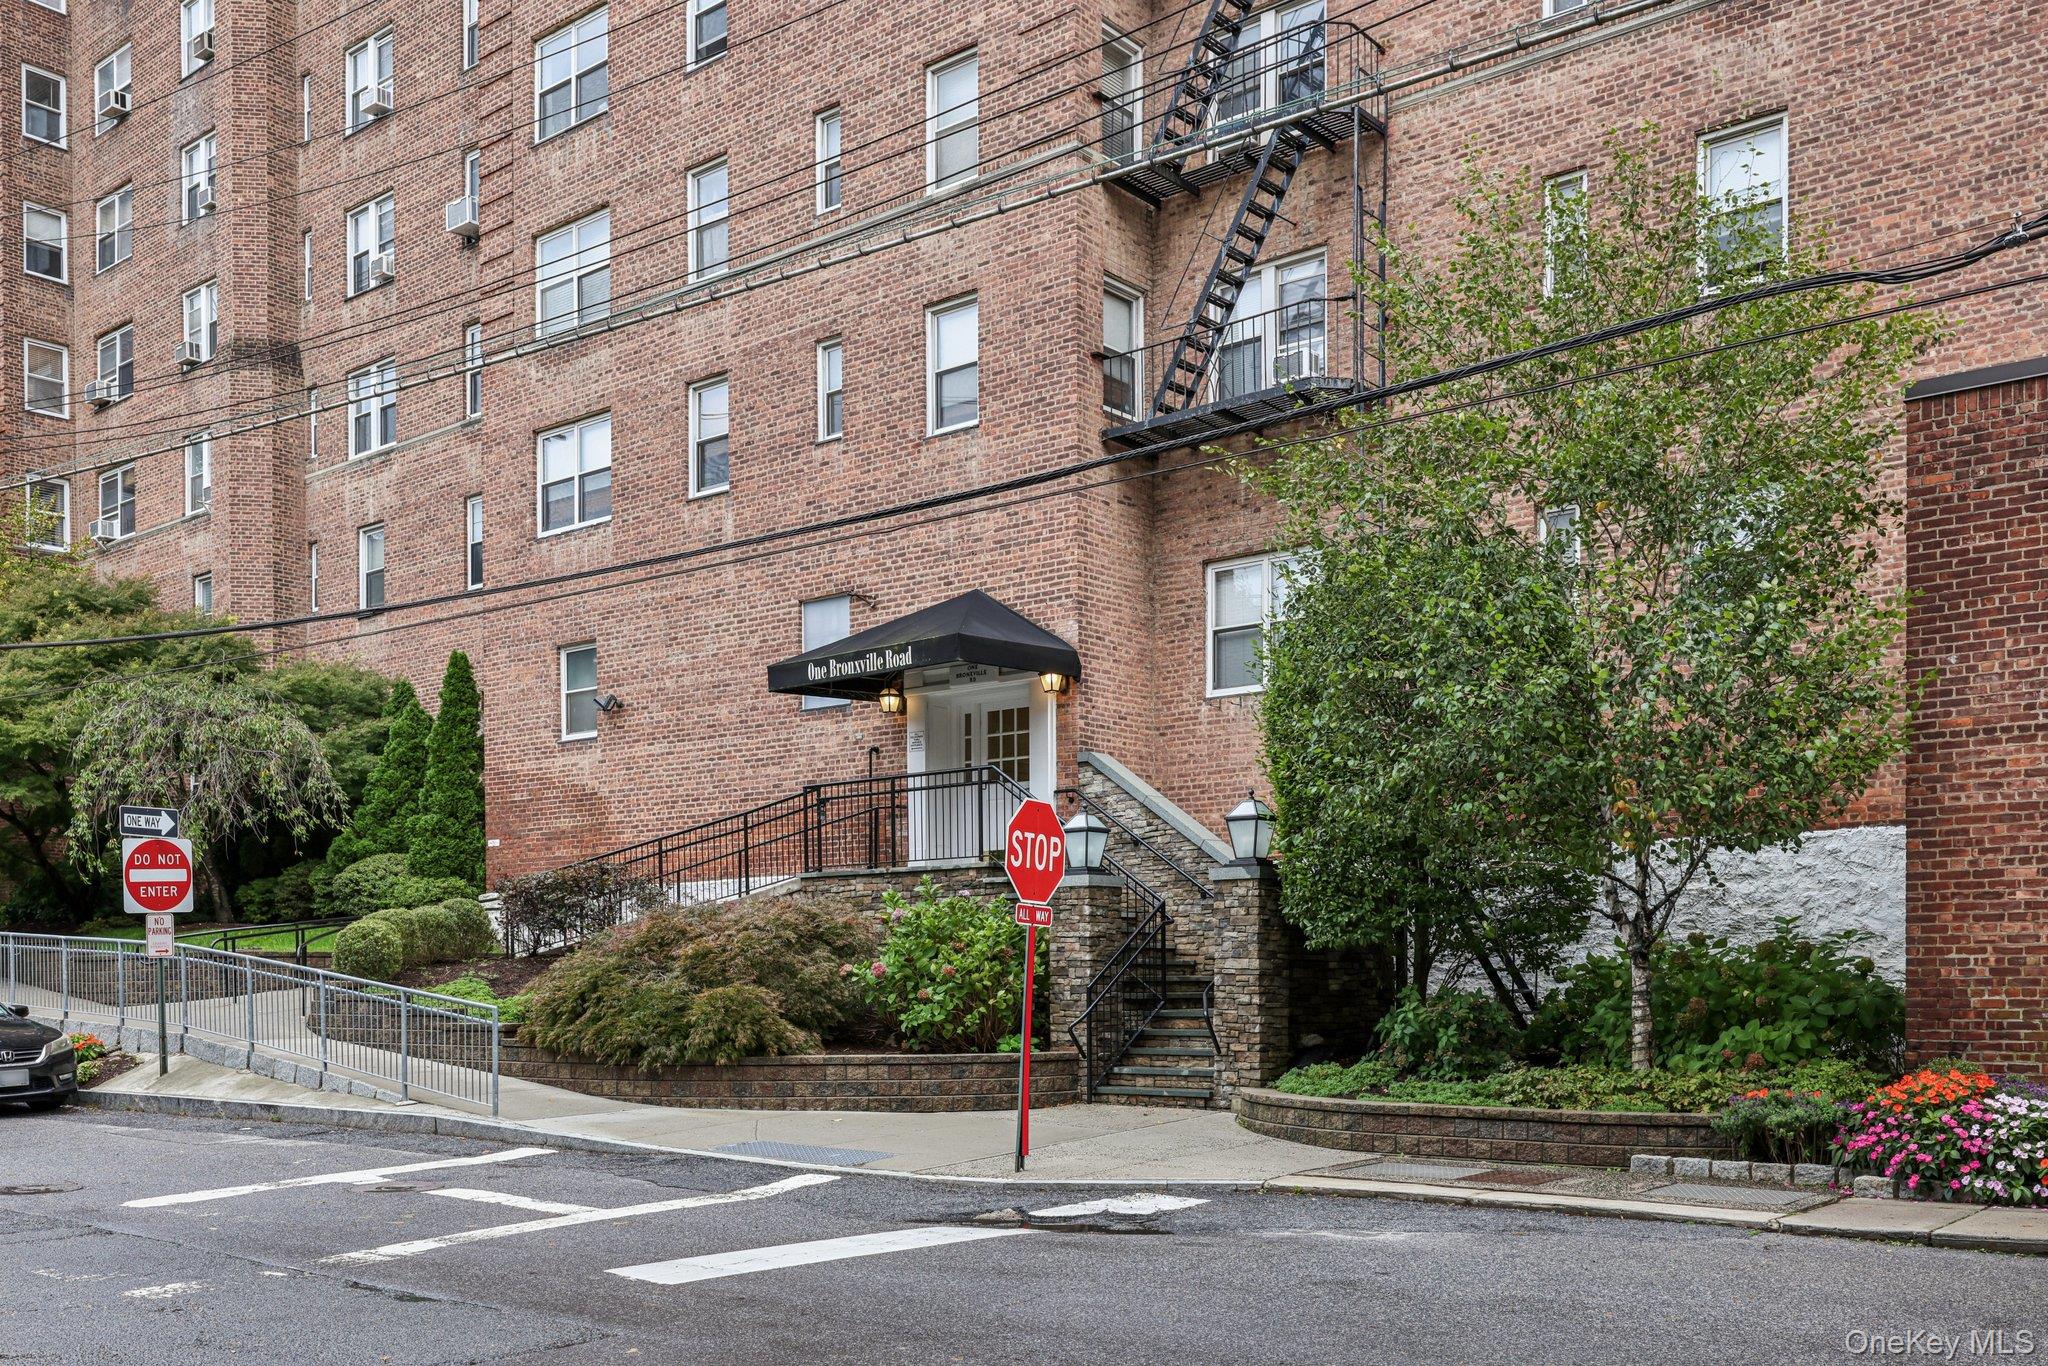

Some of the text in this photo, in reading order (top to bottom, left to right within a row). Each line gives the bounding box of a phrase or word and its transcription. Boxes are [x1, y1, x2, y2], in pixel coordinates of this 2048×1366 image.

[808, 646, 912, 681] One Bronxville Road
[126, 815, 161, 828] ONE WAY
[1010, 829, 1062, 872] STOP
[134, 853, 181, 865] DO NOT
[140, 886, 178, 898] ENTER
[154, 917, 165, 926] NO
[1018, 909, 1049, 922] ALL WAY
[148, 927, 172, 936] PARKING
